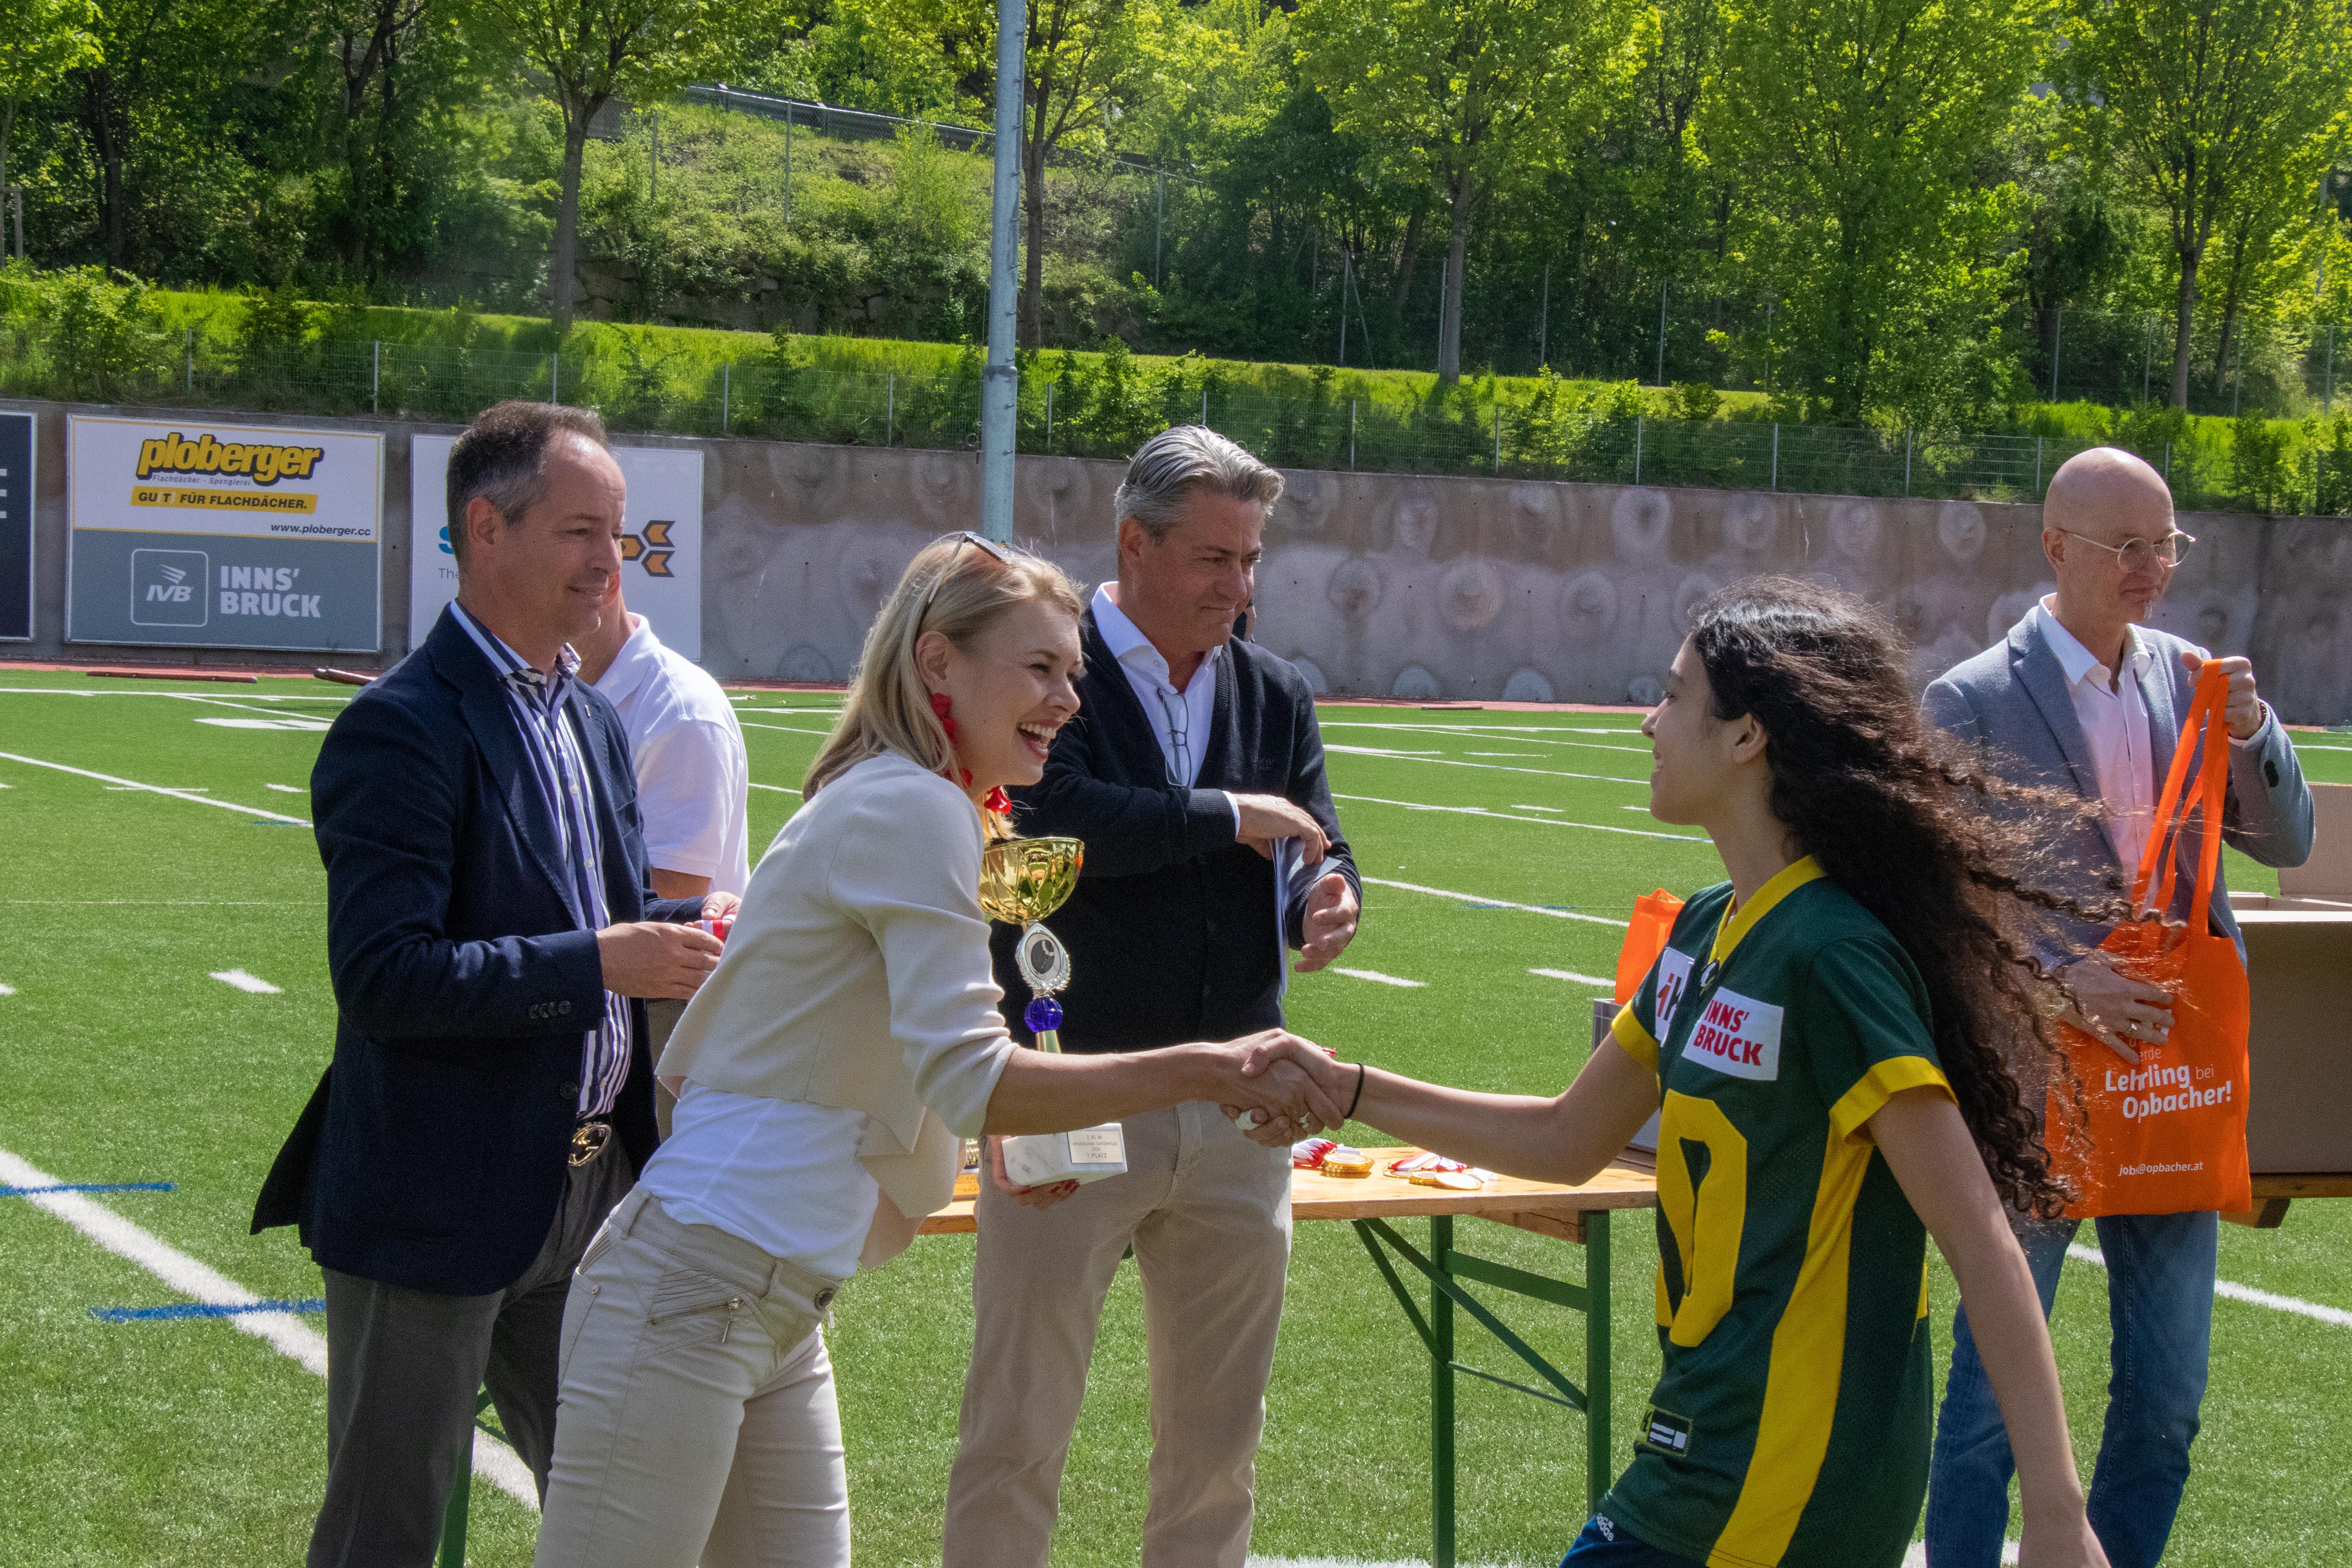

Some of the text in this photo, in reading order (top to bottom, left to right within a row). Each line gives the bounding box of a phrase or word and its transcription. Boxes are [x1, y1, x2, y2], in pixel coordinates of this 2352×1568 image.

[136, 432, 324, 486] ploberger
[152, 474, 200, 483] Flachdächer
[209, 477, 251, 486] Spenglerei
[180, 492, 206, 504] FÜR
[209, 495, 307, 509] FLACHDÄCHER.
[271, 524, 371, 536] www.ploberger.cc
[146, 585, 192, 602] IVB
[220, 592, 322, 618] BRUCK
[1693, 1024, 1763, 1066] BRUCK
[2105, 1063, 2214, 1092] Lehrling bei
[2122, 1080, 2231, 1123] Opbacher!
